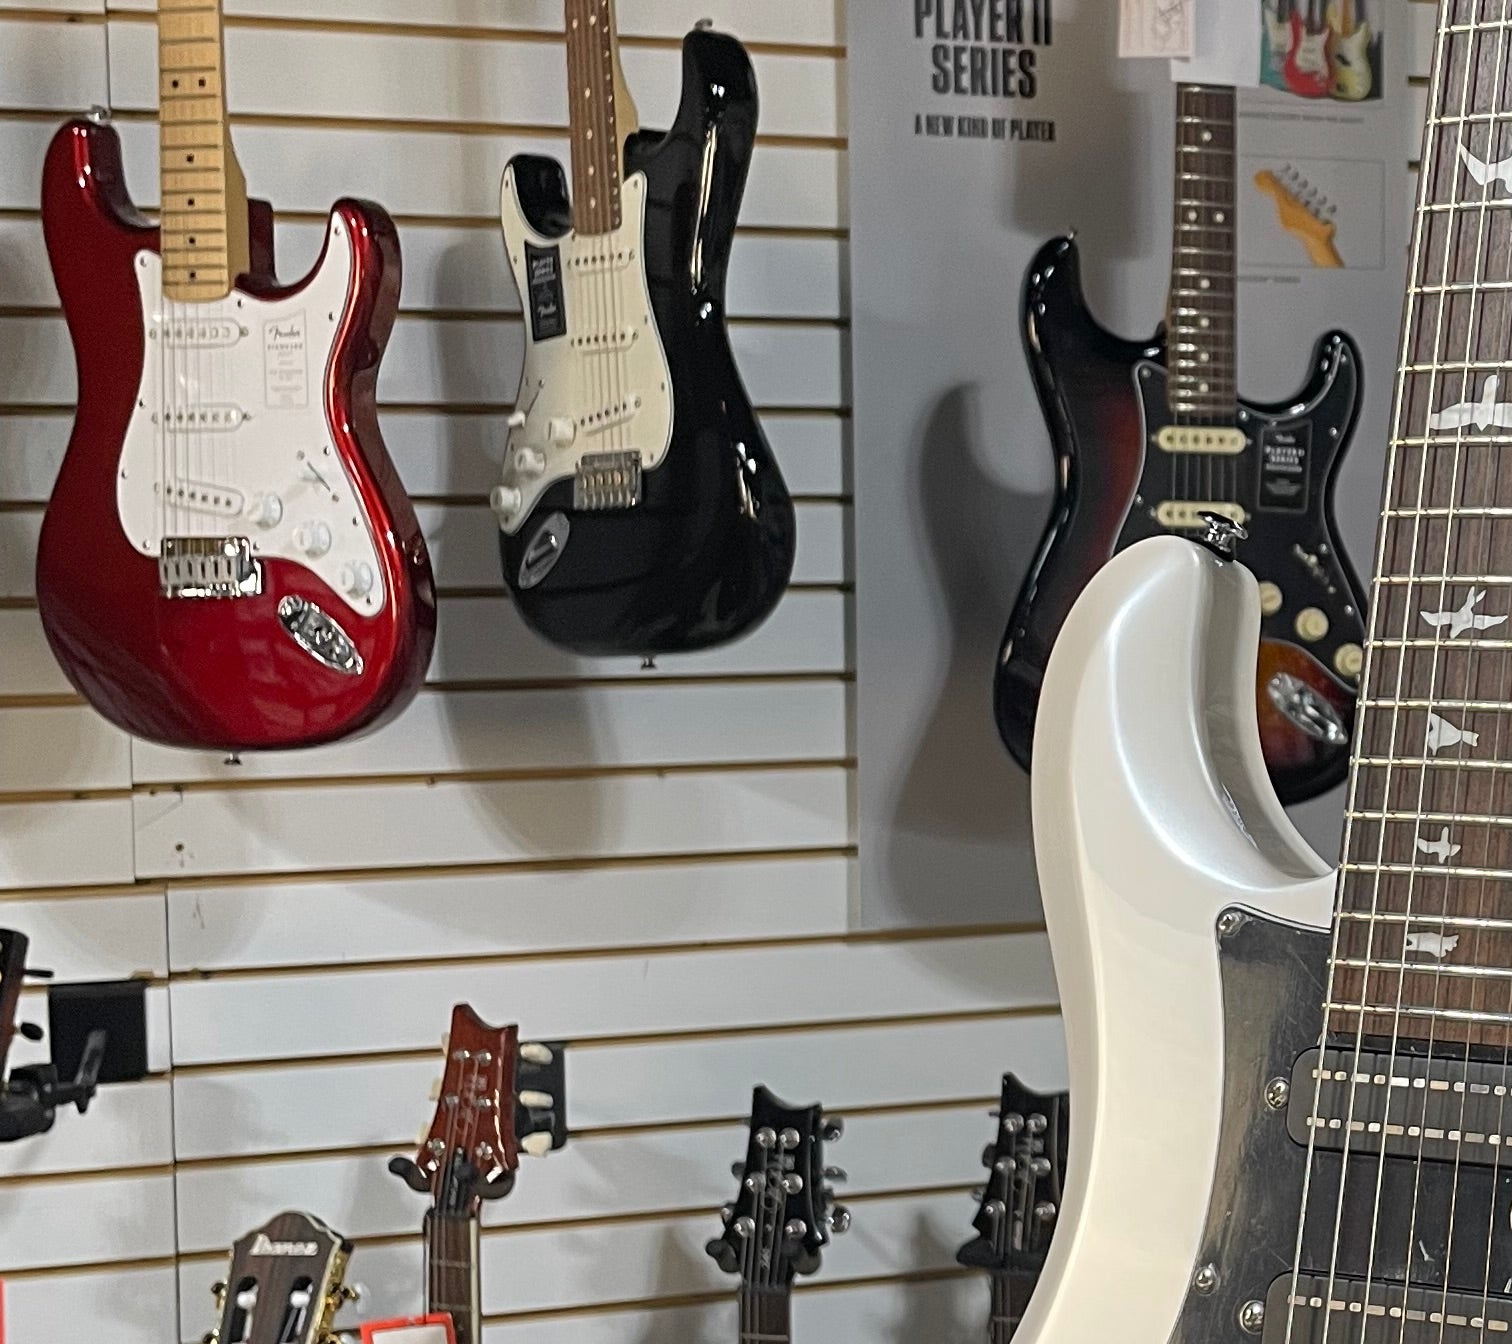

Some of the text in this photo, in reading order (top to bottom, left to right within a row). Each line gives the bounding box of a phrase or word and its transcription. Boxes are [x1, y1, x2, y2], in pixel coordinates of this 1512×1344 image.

[931, 44, 1037, 99] SERIES
[926, 114, 954, 137] NEW
[958, 115, 988, 139] KIND
[1009, 118, 1056, 143] PLAYER
